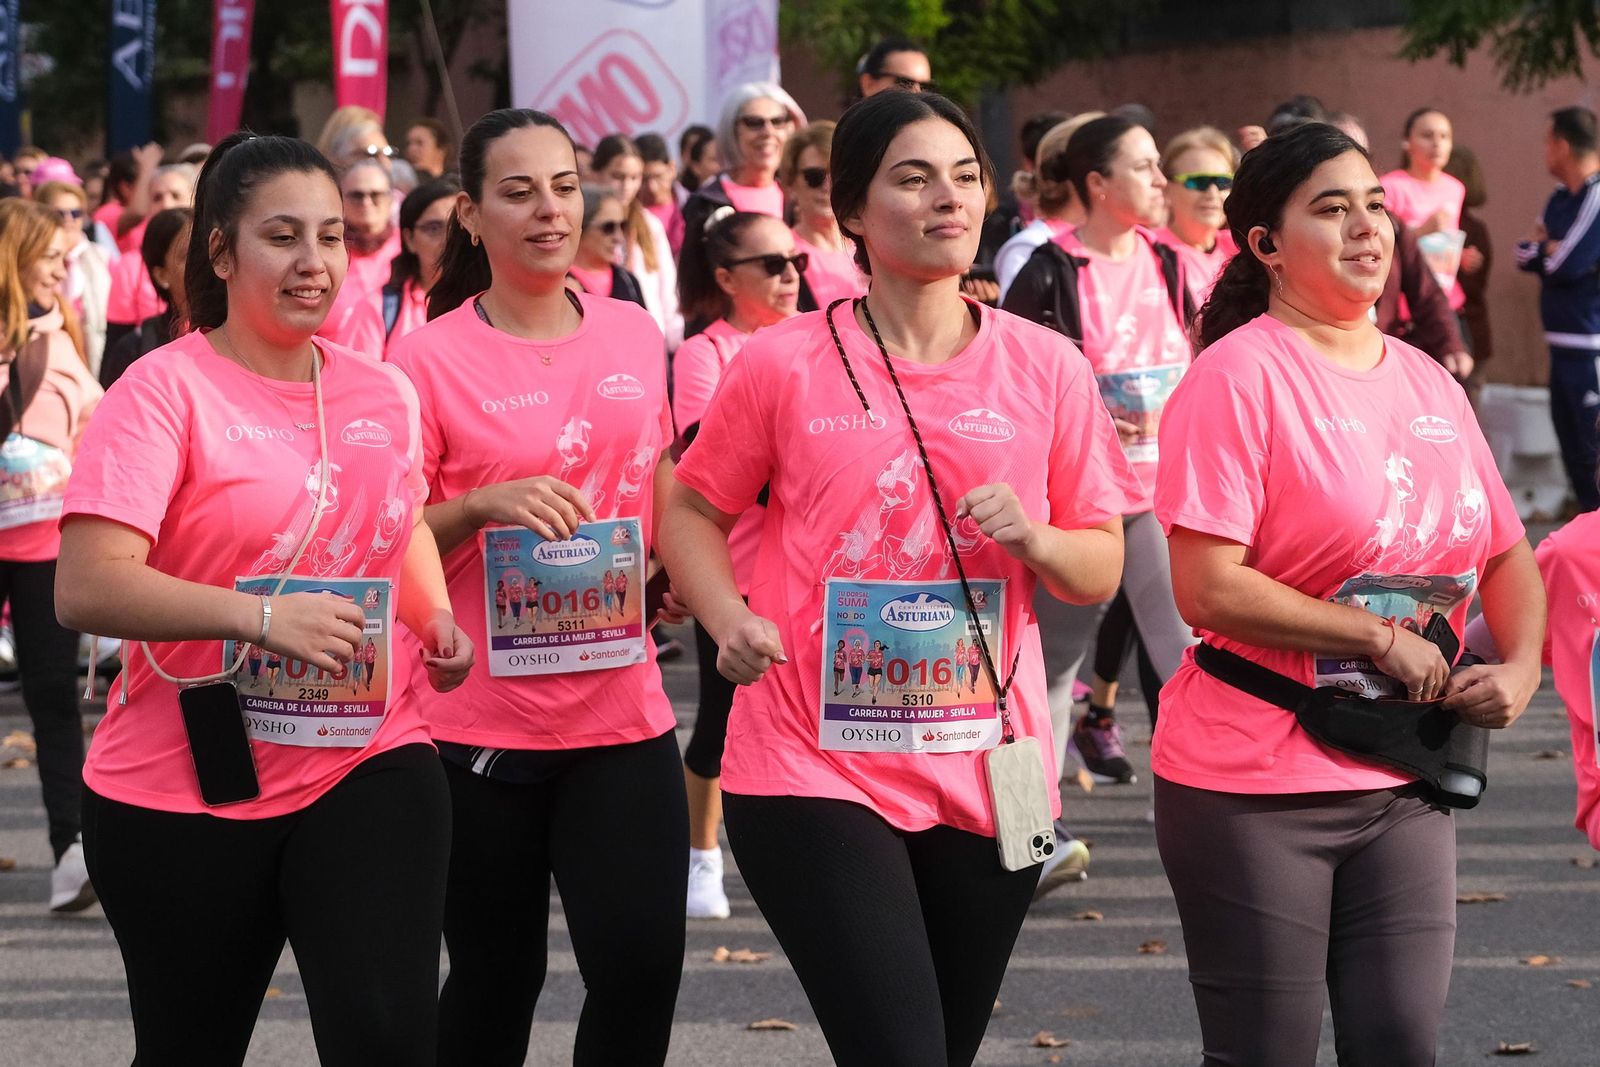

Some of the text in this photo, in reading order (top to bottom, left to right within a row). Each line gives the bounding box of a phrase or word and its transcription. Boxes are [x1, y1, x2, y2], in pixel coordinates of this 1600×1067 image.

[482, 391, 549, 413] OYSHO
[809, 415, 886, 434] OYSHO
[954, 419, 1011, 437] ASTURIANA
[226, 425, 294, 441] OYSHO
[345, 431, 389, 442] ASTURIANA
[537, 547, 597, 560] ASTURIANA
[366, 590, 378, 602] 20
[542, 588, 600, 615] 016
[838, 598, 868, 608] SUMA
[885, 606, 951, 621] ASTURIANA
[558, 620, 585, 631] 5311
[513, 636, 547, 646] CARRERA
[549, 635, 559, 643] DE
[573, 632, 596, 641] MUJER
[602, 628, 626, 638] SEVILLA
[508, 653, 560, 666] OYSHO
[590, 648, 630, 660] Santander
[887, 658, 952, 686] 016
[1336, 679, 1381, 691] OYSHO
[298, 688, 329, 700] 2349
[902, 693, 933, 706] 5310
[246, 698, 370, 713] CARRERA DE LA MUJER SEVILLA
[849, 707, 976, 718] CARRERA DE LA MUJER SEVILLA
[329, 726, 372, 736] Santander
[841, 728, 901, 742] OYSHO
[936, 729, 981, 741] Santander
